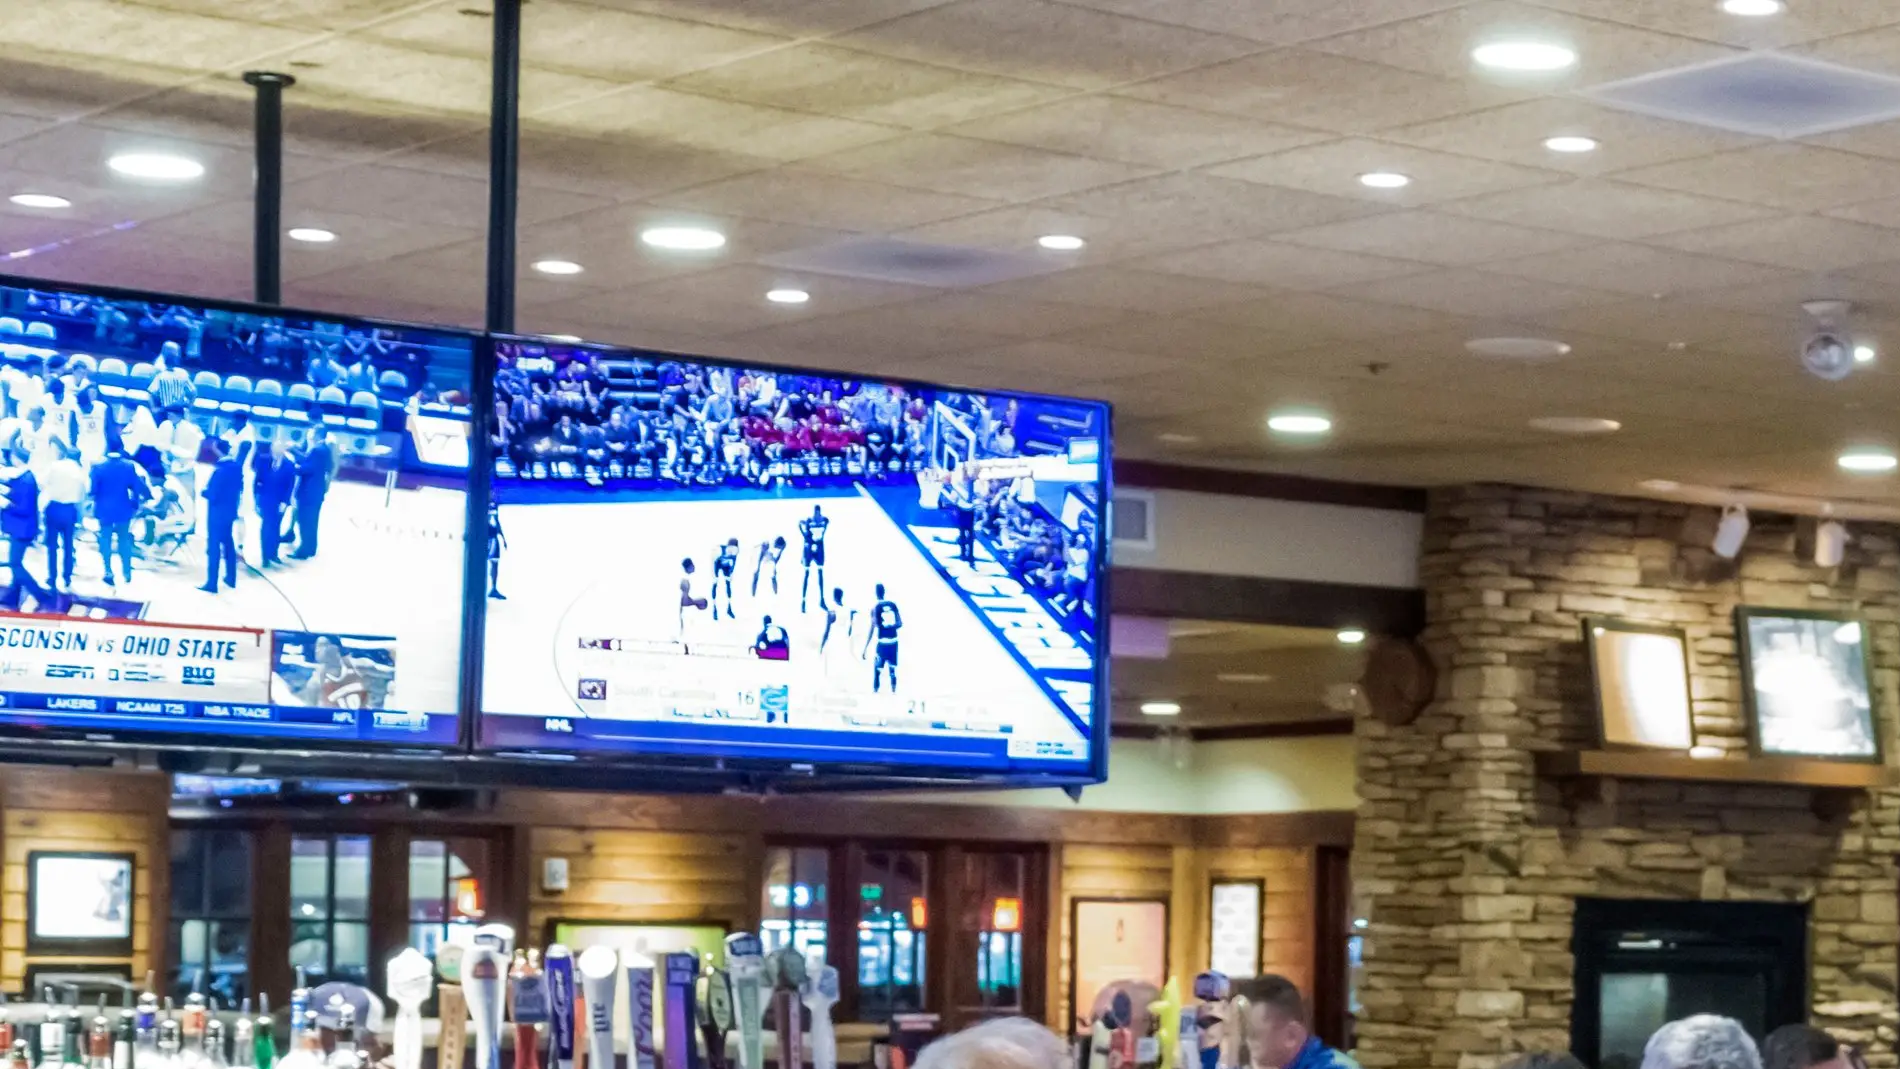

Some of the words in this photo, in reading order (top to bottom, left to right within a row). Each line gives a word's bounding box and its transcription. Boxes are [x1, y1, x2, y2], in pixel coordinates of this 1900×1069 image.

[122, 635, 170, 657] OHIO
[177, 638, 238, 661] STATE
[47, 698, 97, 710] LAKERS
[737, 691, 754, 706] 16
